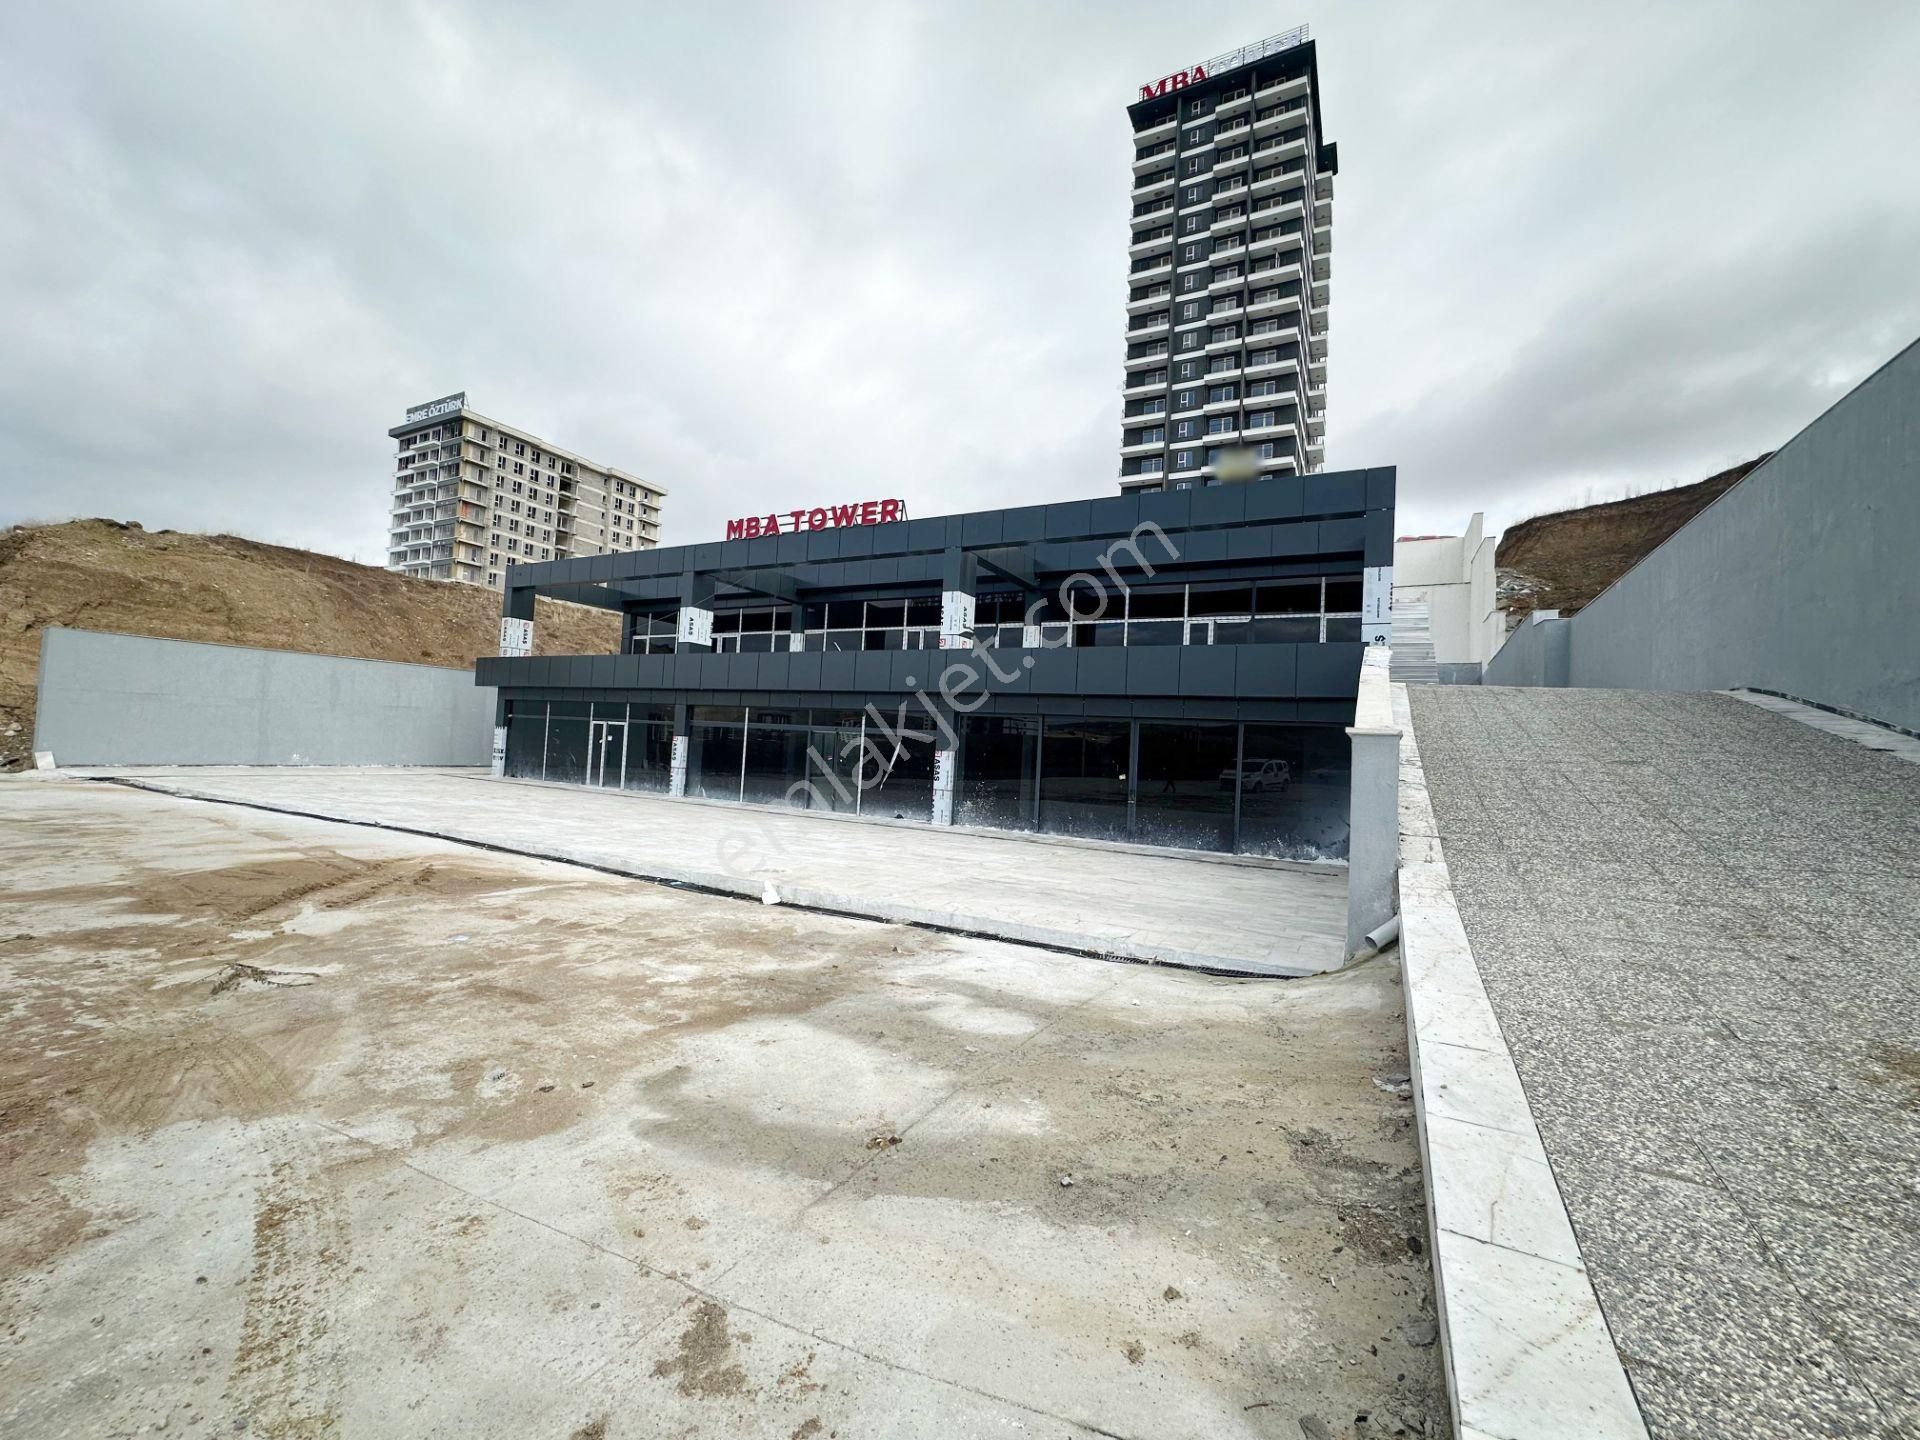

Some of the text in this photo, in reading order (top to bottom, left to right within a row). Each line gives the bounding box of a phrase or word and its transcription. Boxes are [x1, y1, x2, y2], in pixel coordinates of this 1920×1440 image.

[1141, 65, 1208, 100] MBA
[726, 498, 900, 541] MBA TOWER
